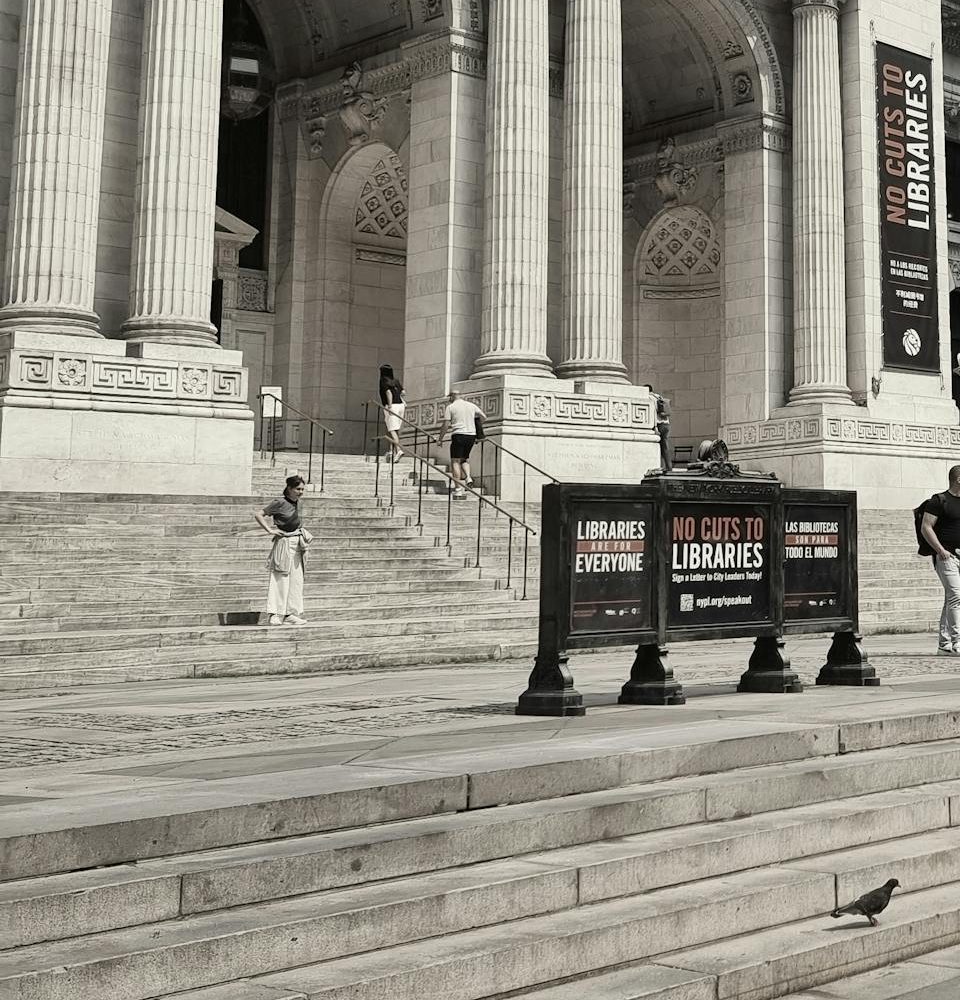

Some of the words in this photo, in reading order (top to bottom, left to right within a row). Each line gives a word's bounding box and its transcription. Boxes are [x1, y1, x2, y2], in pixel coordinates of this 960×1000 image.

[882, 63, 904, 97] TO
[884, 108, 905, 177] CUTS
[905, 69, 930, 231] LIBRARIES
[886, 186, 907, 226] NO
[577, 520, 646, 540] LIBRARIES
[672, 516, 695, 541] NO
[701, 516, 741, 541] CUTS
[745, 517, 764, 541] TO
[785, 521, 798, 533] LAS
[799, 521, 839, 533] BIBLIOTECAS
[590, 541, 609, 551] ARE
[614, 541, 631, 551] FOR
[795, 535, 809, 544] SON
[812, 535, 829, 544] PARA
[575, 553, 644, 573] EVERYONE
[672, 542, 763, 570] LIBRARIES
[785, 547, 803, 559] TODO
[804, 547, 813, 559] EL
[814, 547, 838, 559] MUNDO
[672, 573, 685, 583] Sign
[685, 574, 690, 582] a
[690, 573, 706, 582] Letter
[707, 572, 713, 581] to
[713, 572, 724, 582] City
[725, 572, 745, 581] Leaders
[746, 571, 762, 581] Today!
[696, 594, 752, 608] nypl.org/speakout
